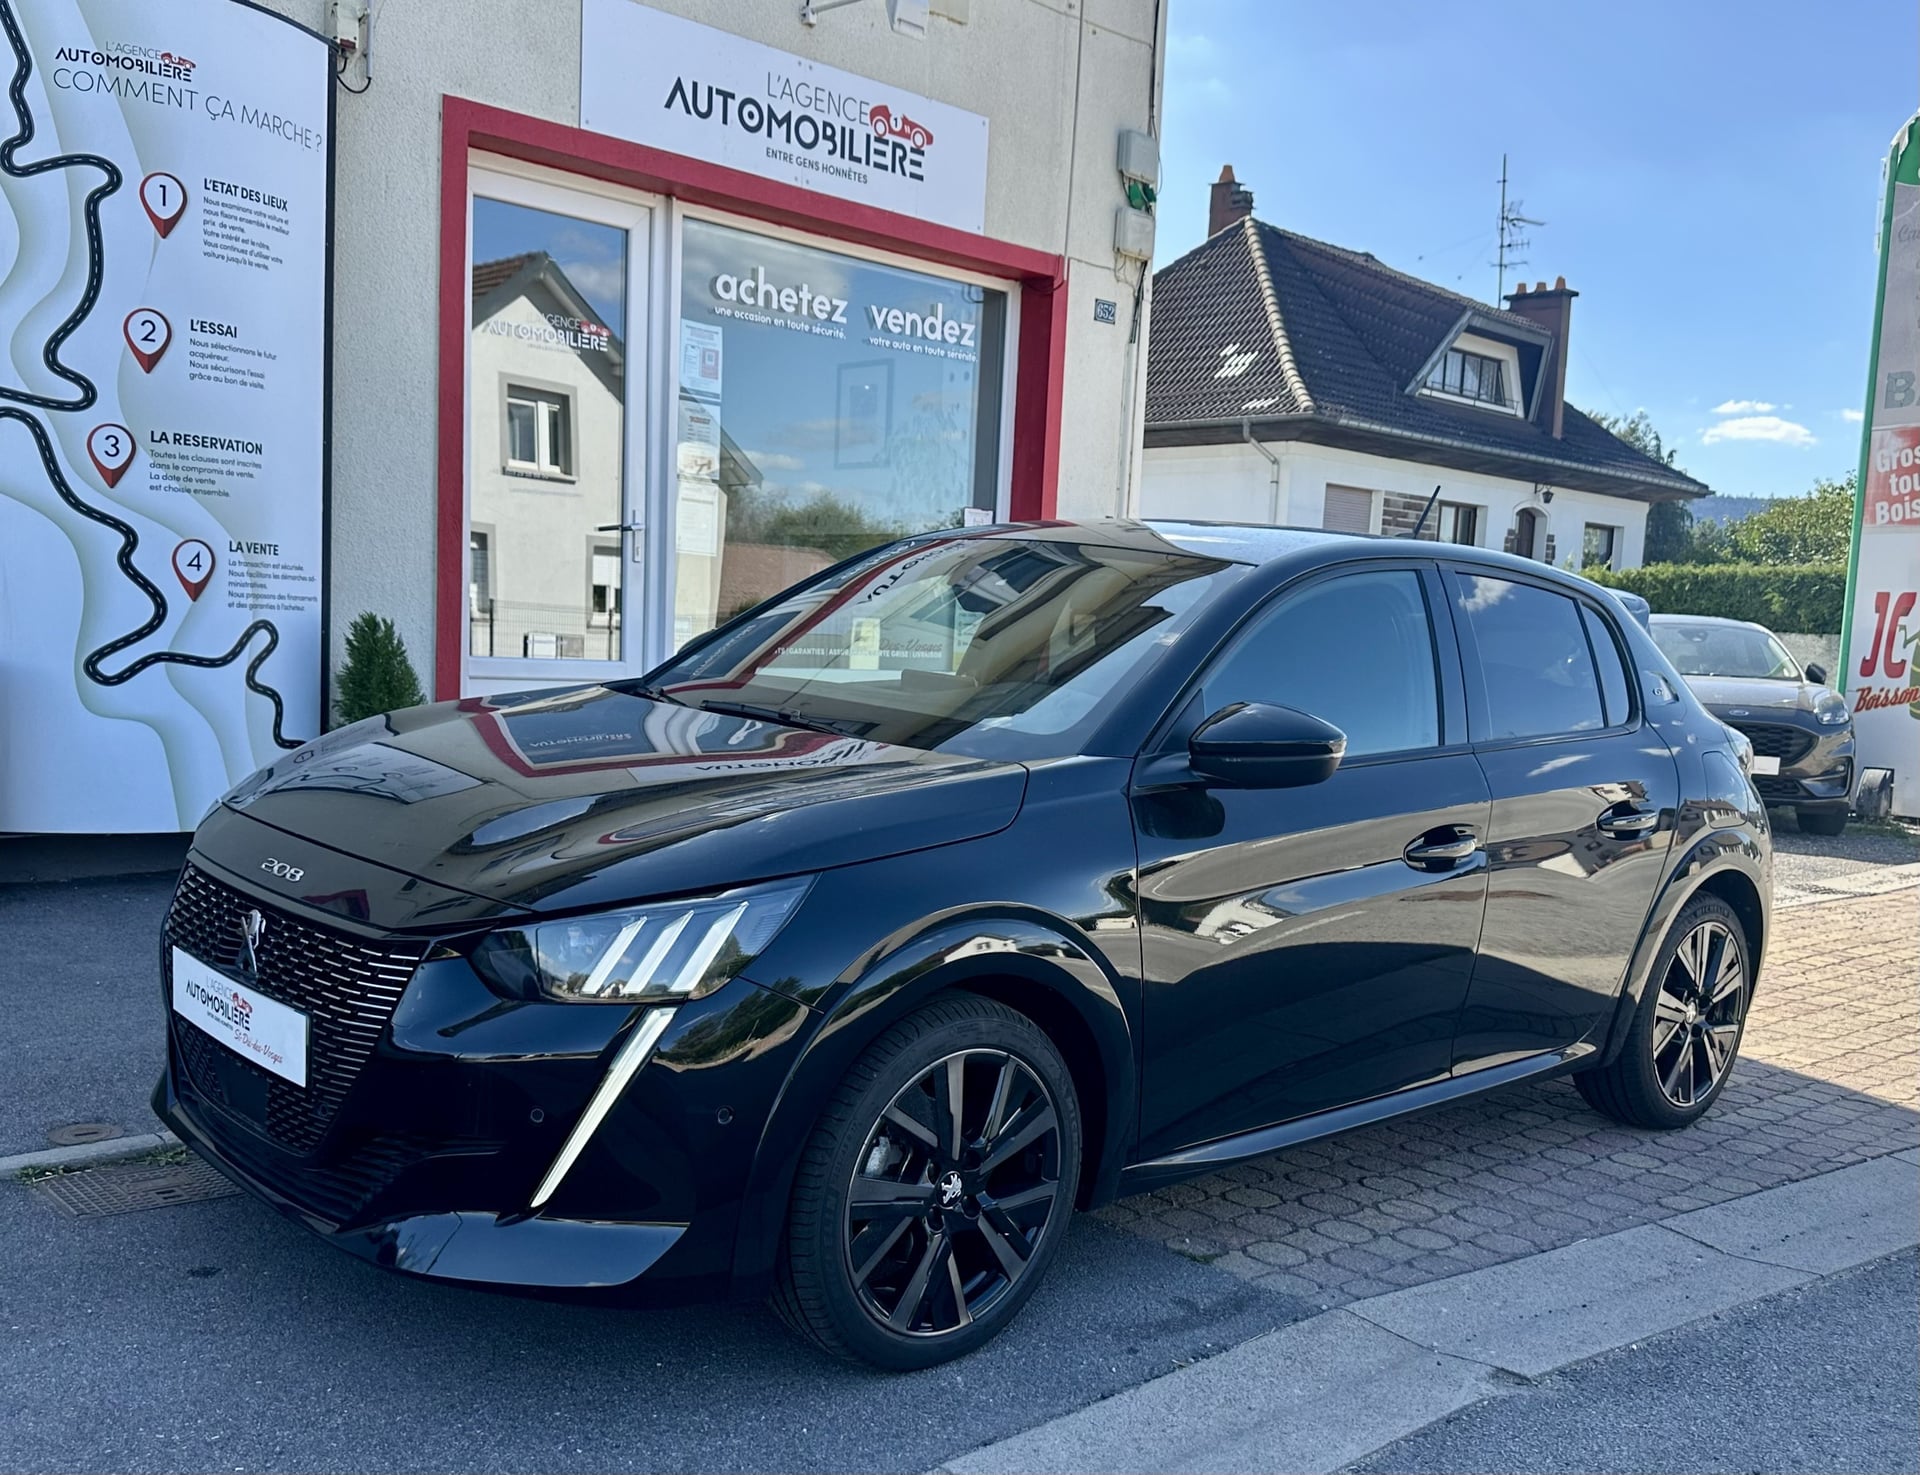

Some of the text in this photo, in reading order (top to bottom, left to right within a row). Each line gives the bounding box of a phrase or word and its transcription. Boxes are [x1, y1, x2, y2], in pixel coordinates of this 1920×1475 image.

[106, 40, 160, 60] L'AGENCE
[54, 68, 198, 110] COMMENT
[206, 96, 235, 121] ÇA
[241, 104, 312, 149] MARCHE
[767, 72, 871, 126] L'AGENCE
[766, 146, 868, 184] ENTRE GENS HONNÊTES
[158, 184, 167, 207] 1
[204, 178, 288, 212] L'ETAT DES LIEUX
[204, 196, 220, 206] Nous
[203, 208, 219, 217] nous
[218, 220, 228, 230] de
[203, 238, 218, 249] Vous
[203, 250, 226, 261] voiture
[716, 266, 848, 324] achetez
[1098, 304, 1114, 320] 652
[140, 319, 156, 342] 2
[190, 318, 238, 338] L'ESSAI
[714, 306, 846, 340] une occasion en toute sécurité.
[870, 302, 976, 347] vendez
[189, 338, 209, 348] Nous
[870, 336, 890, 348] votre
[892, 340, 911, 350] auto
[912, 344, 923, 354] en
[925, 345, 945, 357] toute
[189, 360, 209, 370] Nous
[210, 363, 246, 376] sécurisons
[189, 372, 212, 381] grâce
[224, 376, 238, 385] bon
[239, 378, 248, 386] de
[104, 434, 120, 458] 3
[150, 430, 262, 455] LA RESERVATION
[150, 449, 176, 460] Toutes
[178, 452, 190, 461] les
[191, 453, 219, 464] clauses
[220, 458, 235, 466] sont
[150, 461, 170, 470] dans
[172, 463, 180, 471] le
[181, 464, 224, 476] compromis
[226, 468, 234, 477] de
[150, 472, 216, 486] La date de vente
[1876, 496, 1920, 525] Bois
[229, 540, 280, 556] LA VENTE
[187, 550, 202, 572] 4
[228, 558, 236, 567] La
[228, 569, 244, 578] Nous
[228, 590, 244, 598] Nous
[789, 648, 824, 656] GARANTIES
[260, 858, 305, 882] 208
[206, 976, 233, 1001] L'AGENCE
